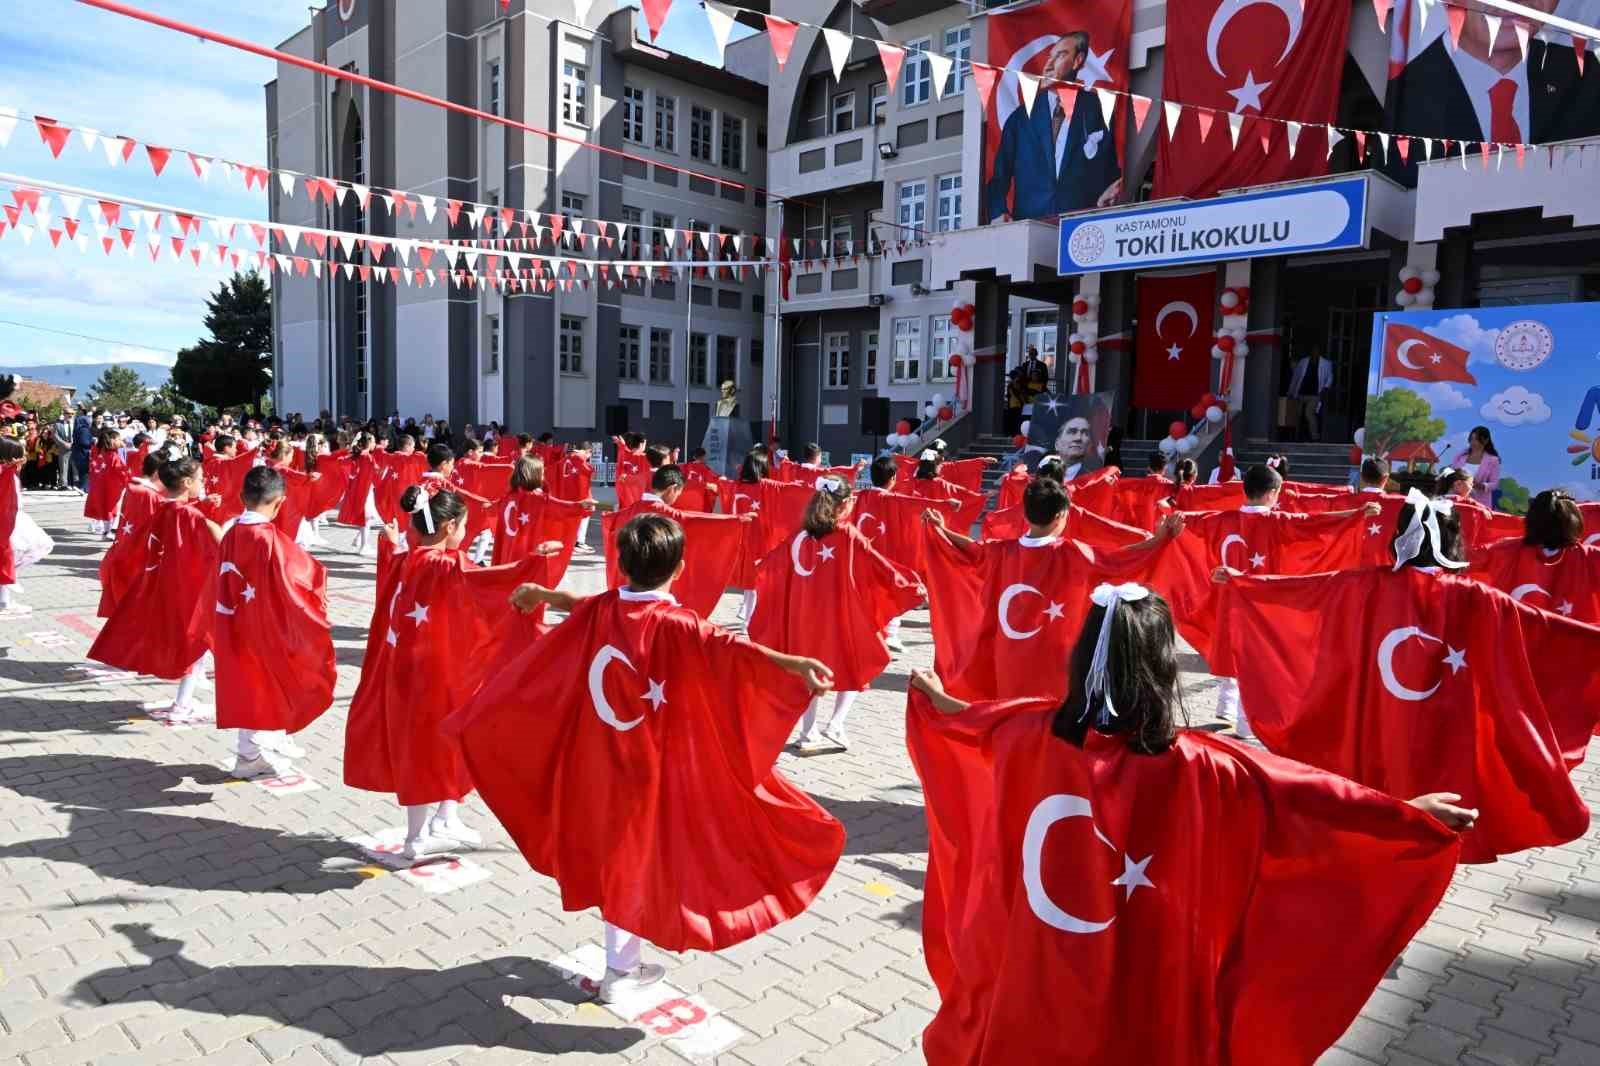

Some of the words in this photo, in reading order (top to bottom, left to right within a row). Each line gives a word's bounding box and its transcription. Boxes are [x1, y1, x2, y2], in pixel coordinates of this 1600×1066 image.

[1115, 215, 1187, 233] KASTAMONU
[1115, 230, 1164, 258] TOKİ
[1171, 219, 1290, 253] İLKOKULU
